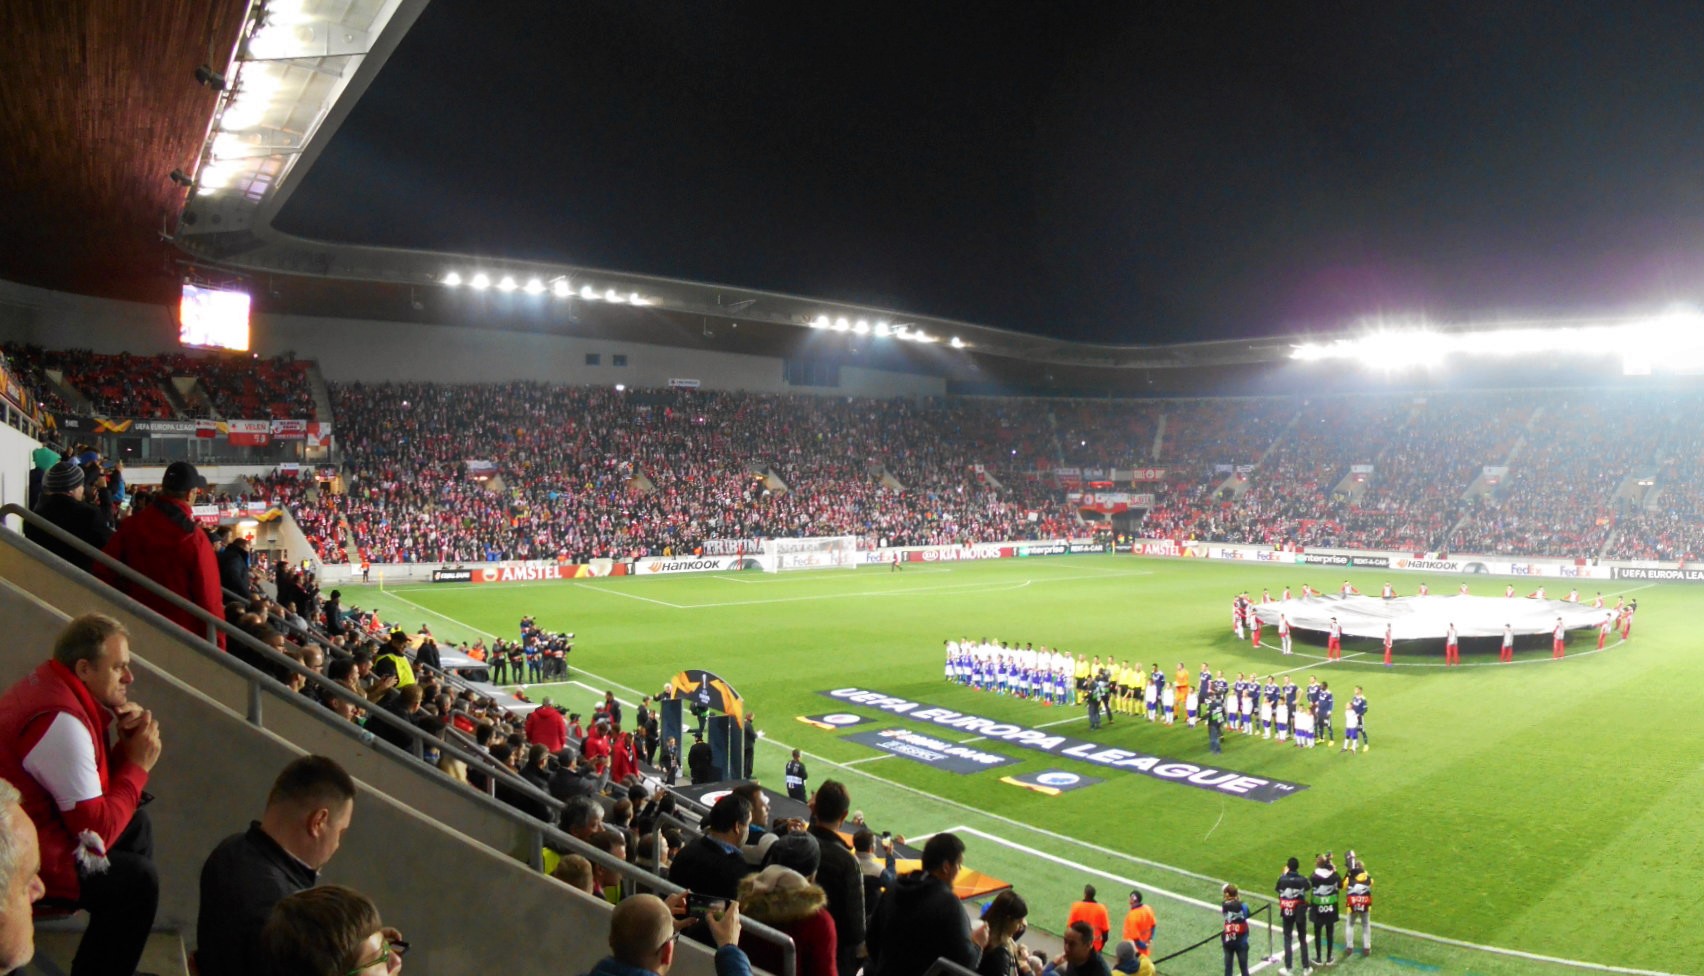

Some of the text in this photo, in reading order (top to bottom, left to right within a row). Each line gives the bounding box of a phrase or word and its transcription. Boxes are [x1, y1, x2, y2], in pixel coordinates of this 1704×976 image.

[1144, 544, 1180, 556] AMSTEL
[501, 566, 562, 582] AMSTEL
[1511, 564, 1541, 575] FedEx
[1560, 566, 1591, 577] FedEx
[1622, 569, 1646, 578] UEFA
[1648, 570, 1684, 579] EUROPA
[830, 687, 919, 713] UEFA
[910, 707, 1066, 749] EUROPA
[1061, 743, 1269, 793] LEAGUE
